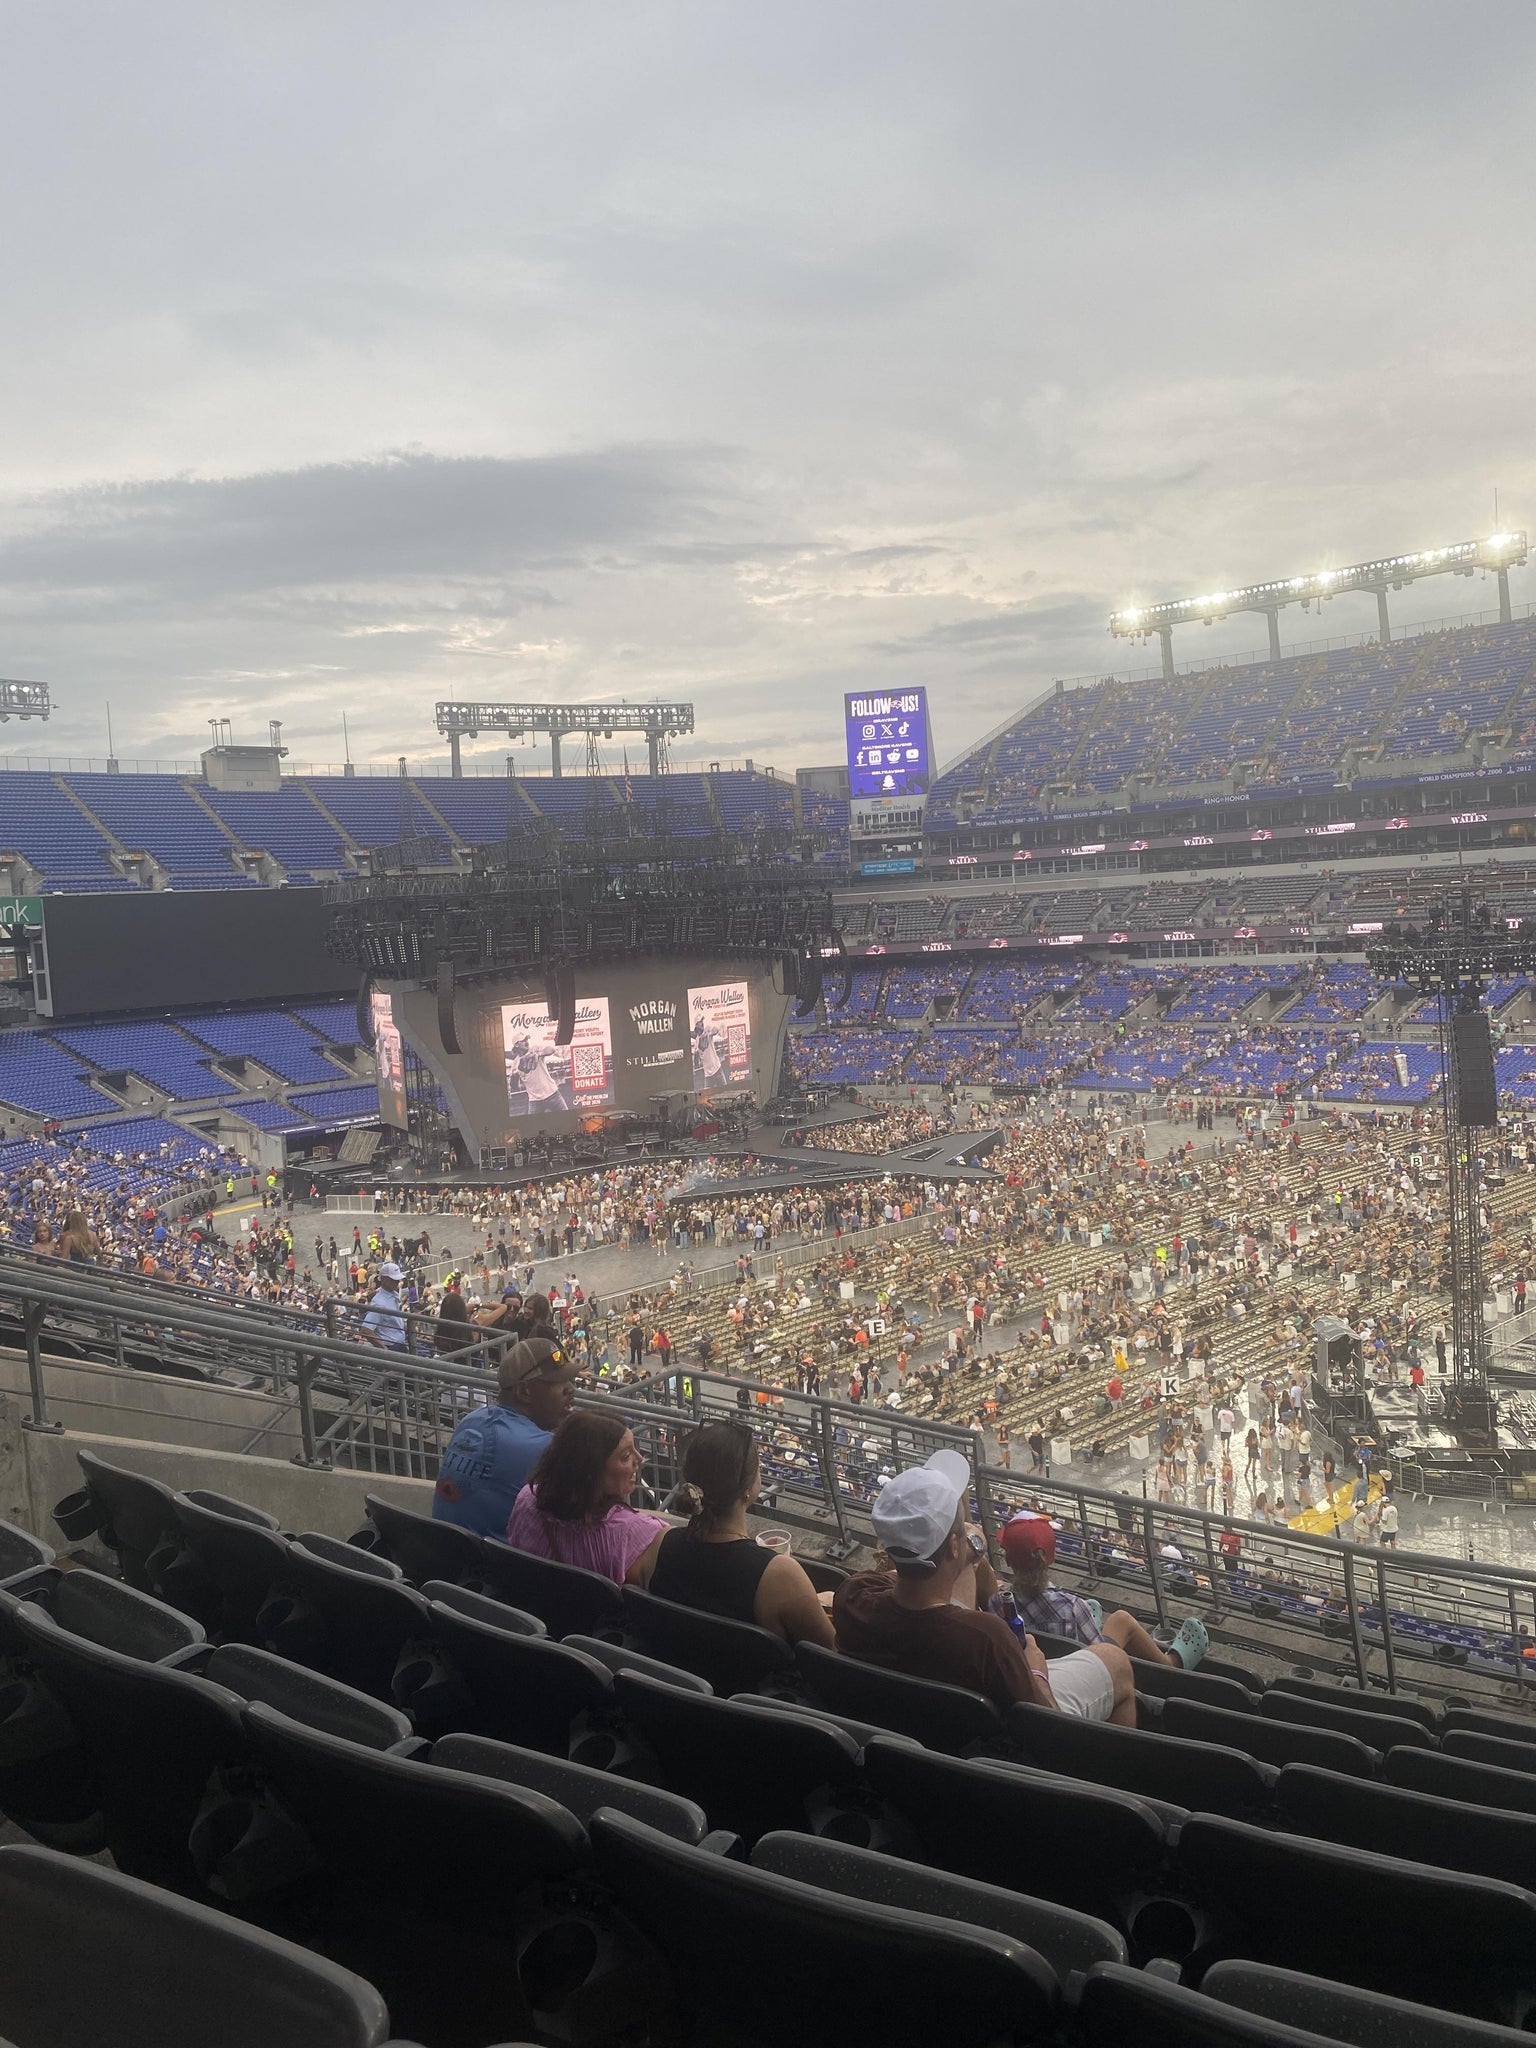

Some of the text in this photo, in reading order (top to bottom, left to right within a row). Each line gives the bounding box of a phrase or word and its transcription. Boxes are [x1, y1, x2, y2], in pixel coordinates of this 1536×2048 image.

[851, 694, 919, 717] FOLLOW US!
[1418, 775, 1440, 783] WORLD
[1440, 770, 1475, 781] CHAMPIONS
[1516, 765, 1532, 773] 2012
[1204, 797, 1221, 805] RING
[1224, 794, 1250, 803] HONOR
[893, 803, 911, 811] Health
[1451, 814, 1488, 825] WALLEN
[1305, 826, 1328, 834] STILL
[1184, 837, 1214, 846] WALLEN
[1061, 847, 1082, 855] STILL
[948, 856, 978, 865] WALLEN
[1163, 932, 1195, 941] WALLEN
[922, 943, 952, 952] WALLEN
[692, 988, 744, 1011] Morgan Wallen
[575, 1006, 602, 1019] allen
[629, 1000, 677, 1021] MORGAN
[637, 1017, 674, 1035] WALLEN
[626, 1055, 657, 1066] STILL
[575, 1078, 605, 1089] DONATE
[1516, 1124, 1521, 1132] A
[1413, 1157, 1421, 1166] B
[873, 1321, 883, 1334] E
[1165, 1379, 1178, 1394] K
[455, 1457, 492, 1481] LIFE
